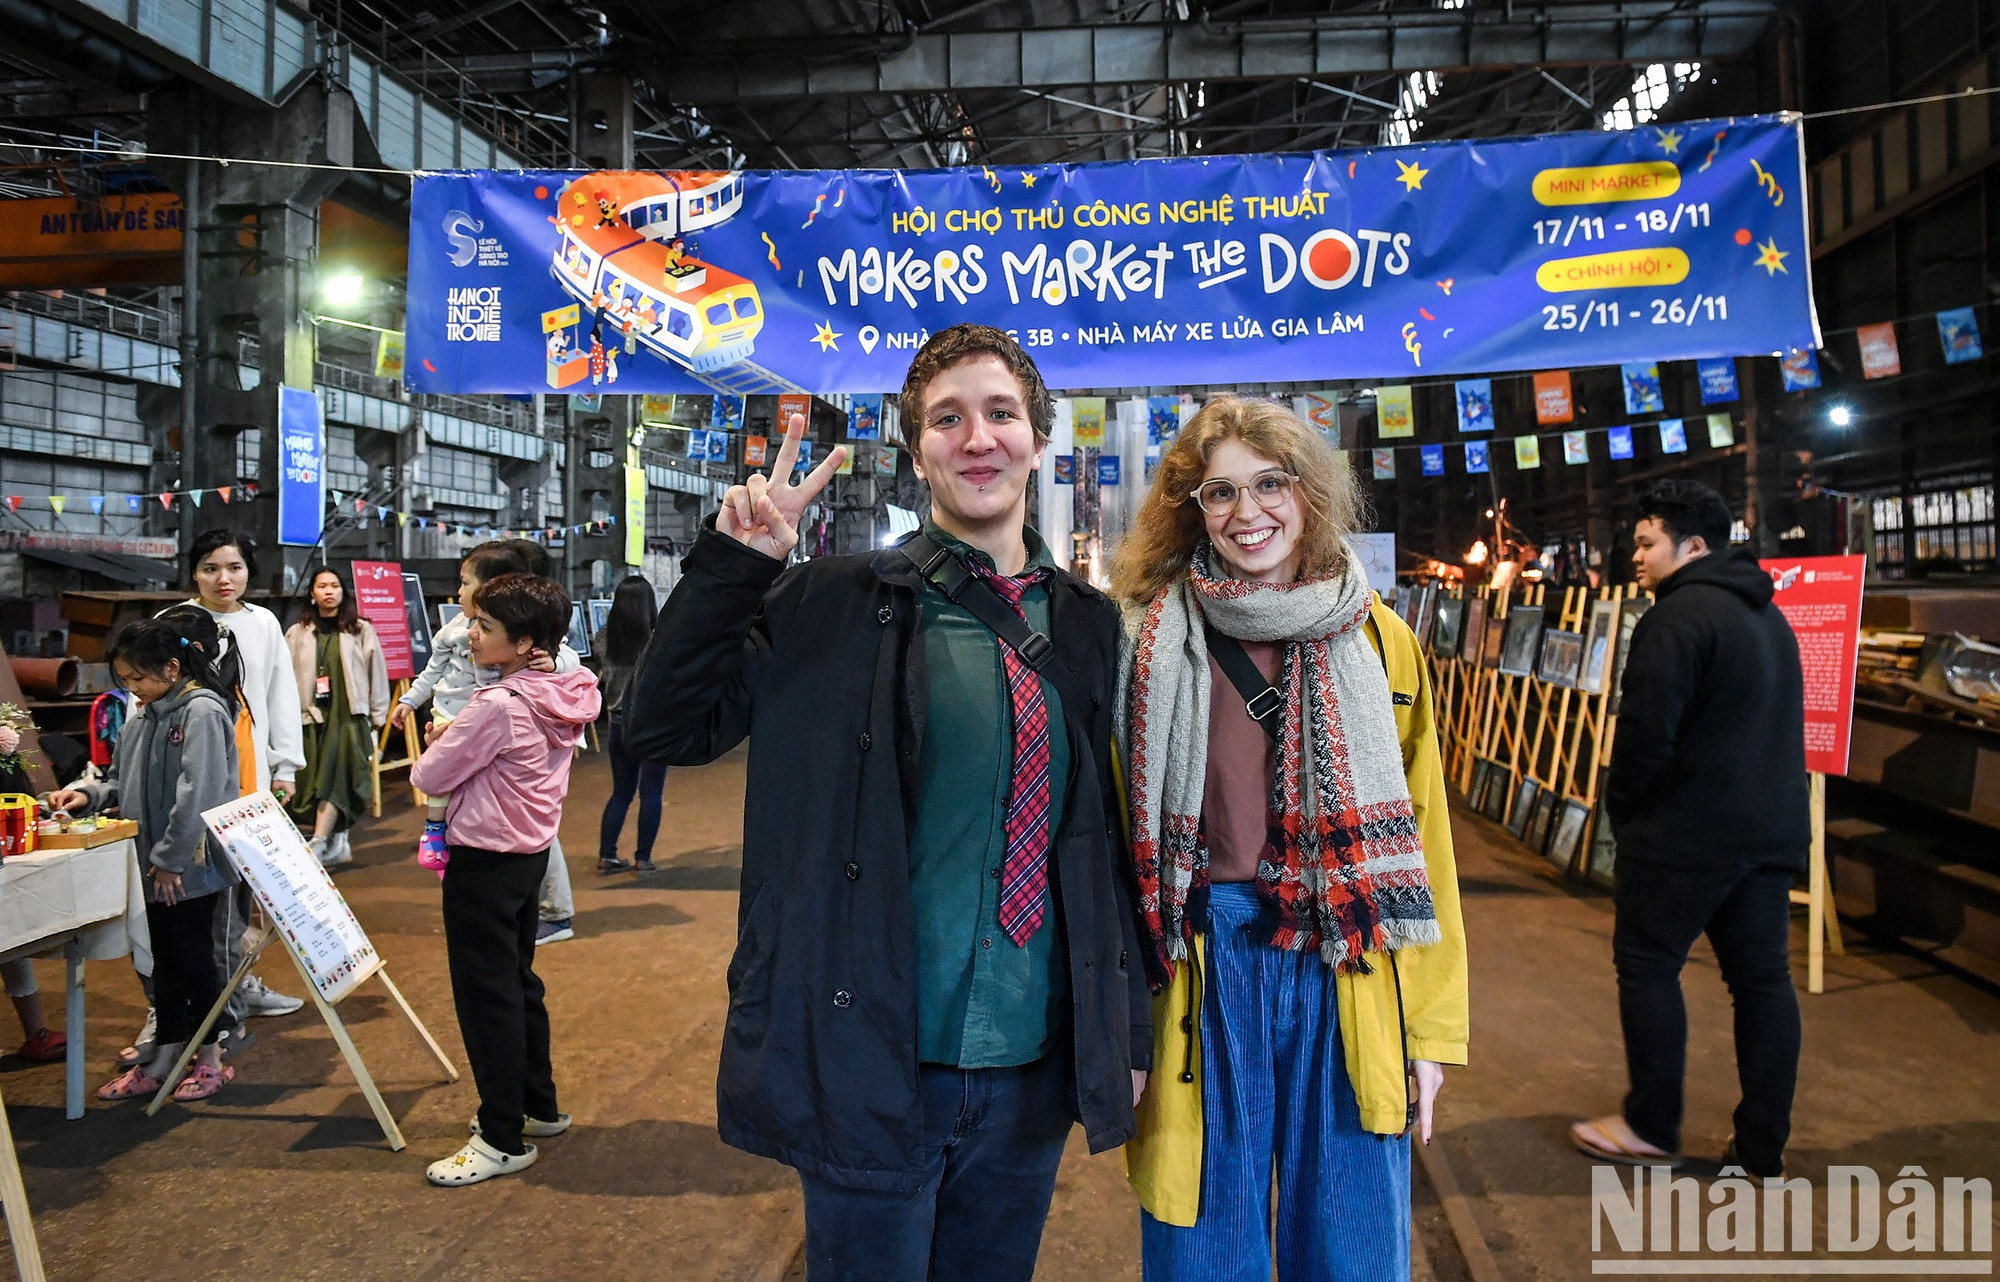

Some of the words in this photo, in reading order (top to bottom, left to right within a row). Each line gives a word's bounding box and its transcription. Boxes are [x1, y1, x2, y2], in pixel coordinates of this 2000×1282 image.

[1550, 179, 1585, 194] MINI
[1591, 172, 1661, 192] MARKET
[892, 205, 936, 237] HỘI
[944, 206, 1003, 236] CHỢ
[1010, 199, 1065, 231] THỦ
[1073, 198, 1150, 227] CÔNG
[1159, 193, 1234, 226] NGHỆ
[1242, 188, 1330, 220] THUẬT
[1533, 214, 1605, 248] 17/11
[1634, 202, 1711, 234] 18/11
[1259, 228, 1411, 294] DOTS
[1567, 262, 1624, 281] CHÍNH
[1630, 256, 1661, 277] HỘI
[447, 286, 501, 306] HANOI
[1542, 300, 1620, 333] 25/11
[1651, 293, 1728, 327] 26/11
[1027, 328, 1055, 347] 3B
[1077, 321, 1125, 345] NHÀ
[1133, 320, 1178, 343] MÁY
[1185, 322, 1214, 341] XE
[1221, 315, 1264, 340] LỬA
[1271, 317, 1309, 337] GIA
[1317, 311, 1365, 335] LÂM
